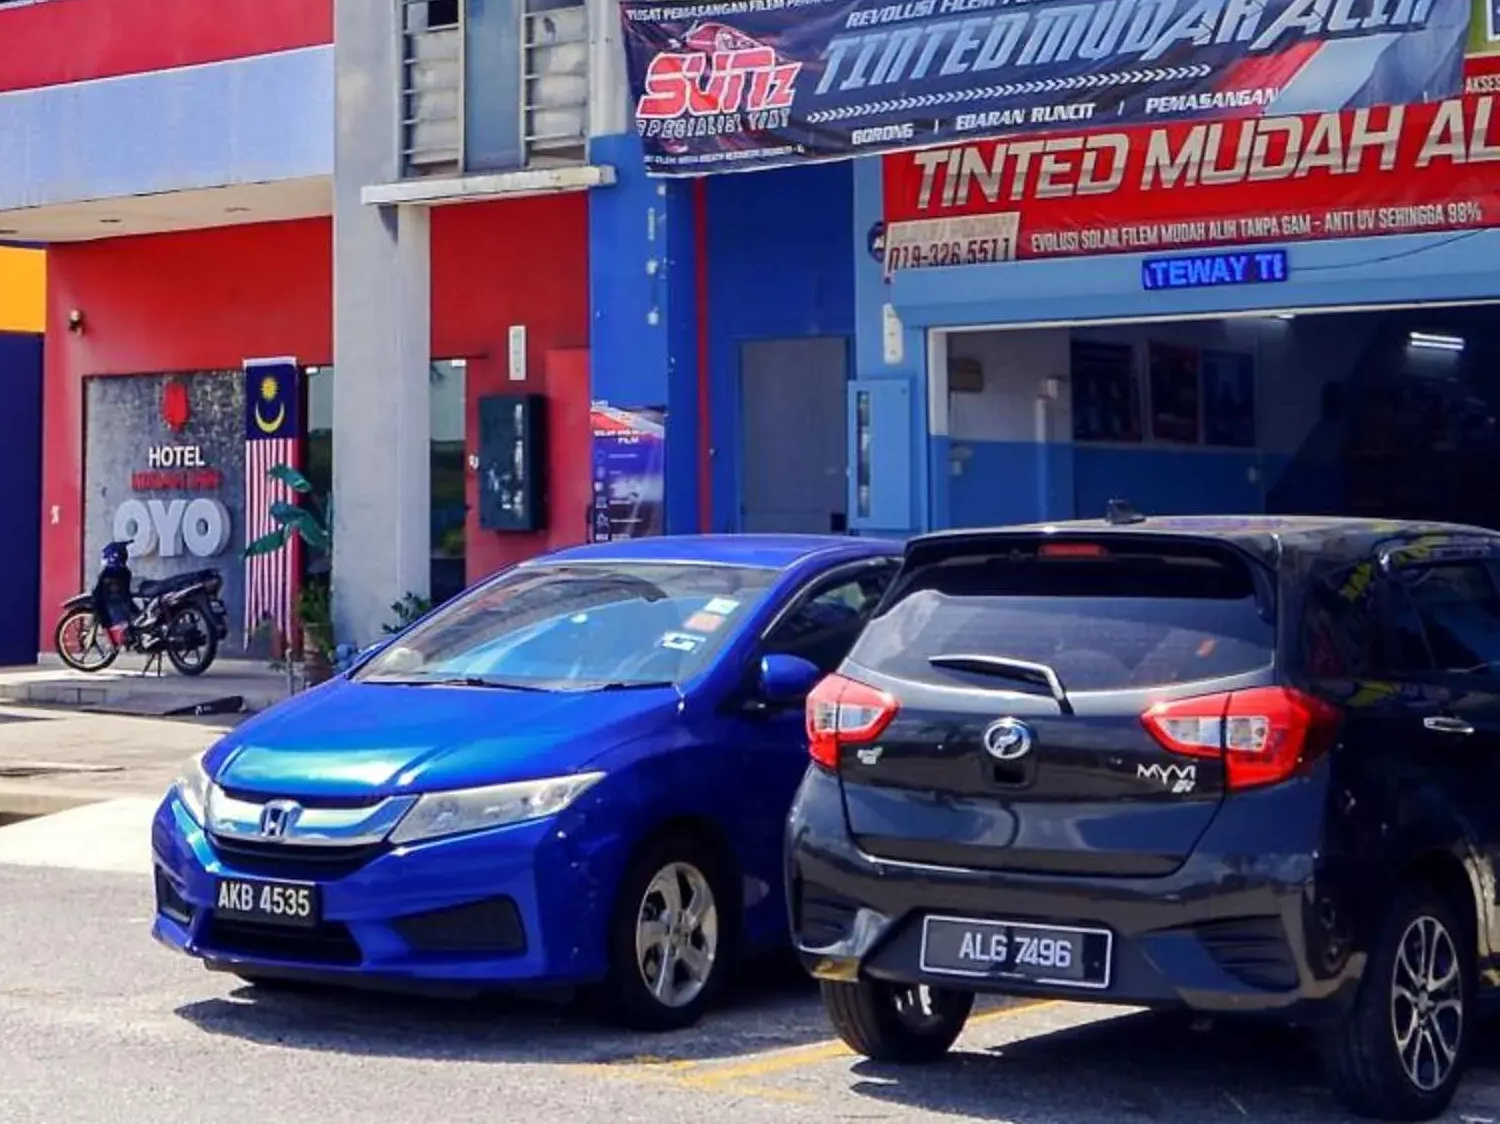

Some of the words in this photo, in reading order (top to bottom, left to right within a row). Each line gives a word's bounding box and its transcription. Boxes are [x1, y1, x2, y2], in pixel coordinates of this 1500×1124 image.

[846, 0, 936, 29] REVOLUSI
[852, 123, 914, 146] BORONG
[956, 110, 1025, 131] EDARAN
[1030, 102, 1097, 123] RUNCIT
[1145, 87, 1278, 115] PEMASANGAN
[913, 133, 1130, 209] TINTED
[1140, 104, 1405, 191] MUDAH
[1081, 228, 1120, 249] SOLAR
[1121, 225, 1159, 246] FILEM
[1160, 222, 1206, 243] MUDAH
[1208, 220, 1237, 239] ALIH
[1240, 216, 1281, 237] TANPA
[1282, 213, 1311, 234] GAM
[1324, 209, 1355, 232] ANTI
[1356, 208, 1375, 230] UV
[1378, 204, 1445, 229] SEHINGGA
[148, 445, 205, 468] HOTEL
[113, 497, 232, 558] OYO
[218, 880, 253, 911] AKB
[260, 884, 310, 917] 4535
[958, 932, 1008, 962] ALG
[1013, 936, 1072, 968] 7496
